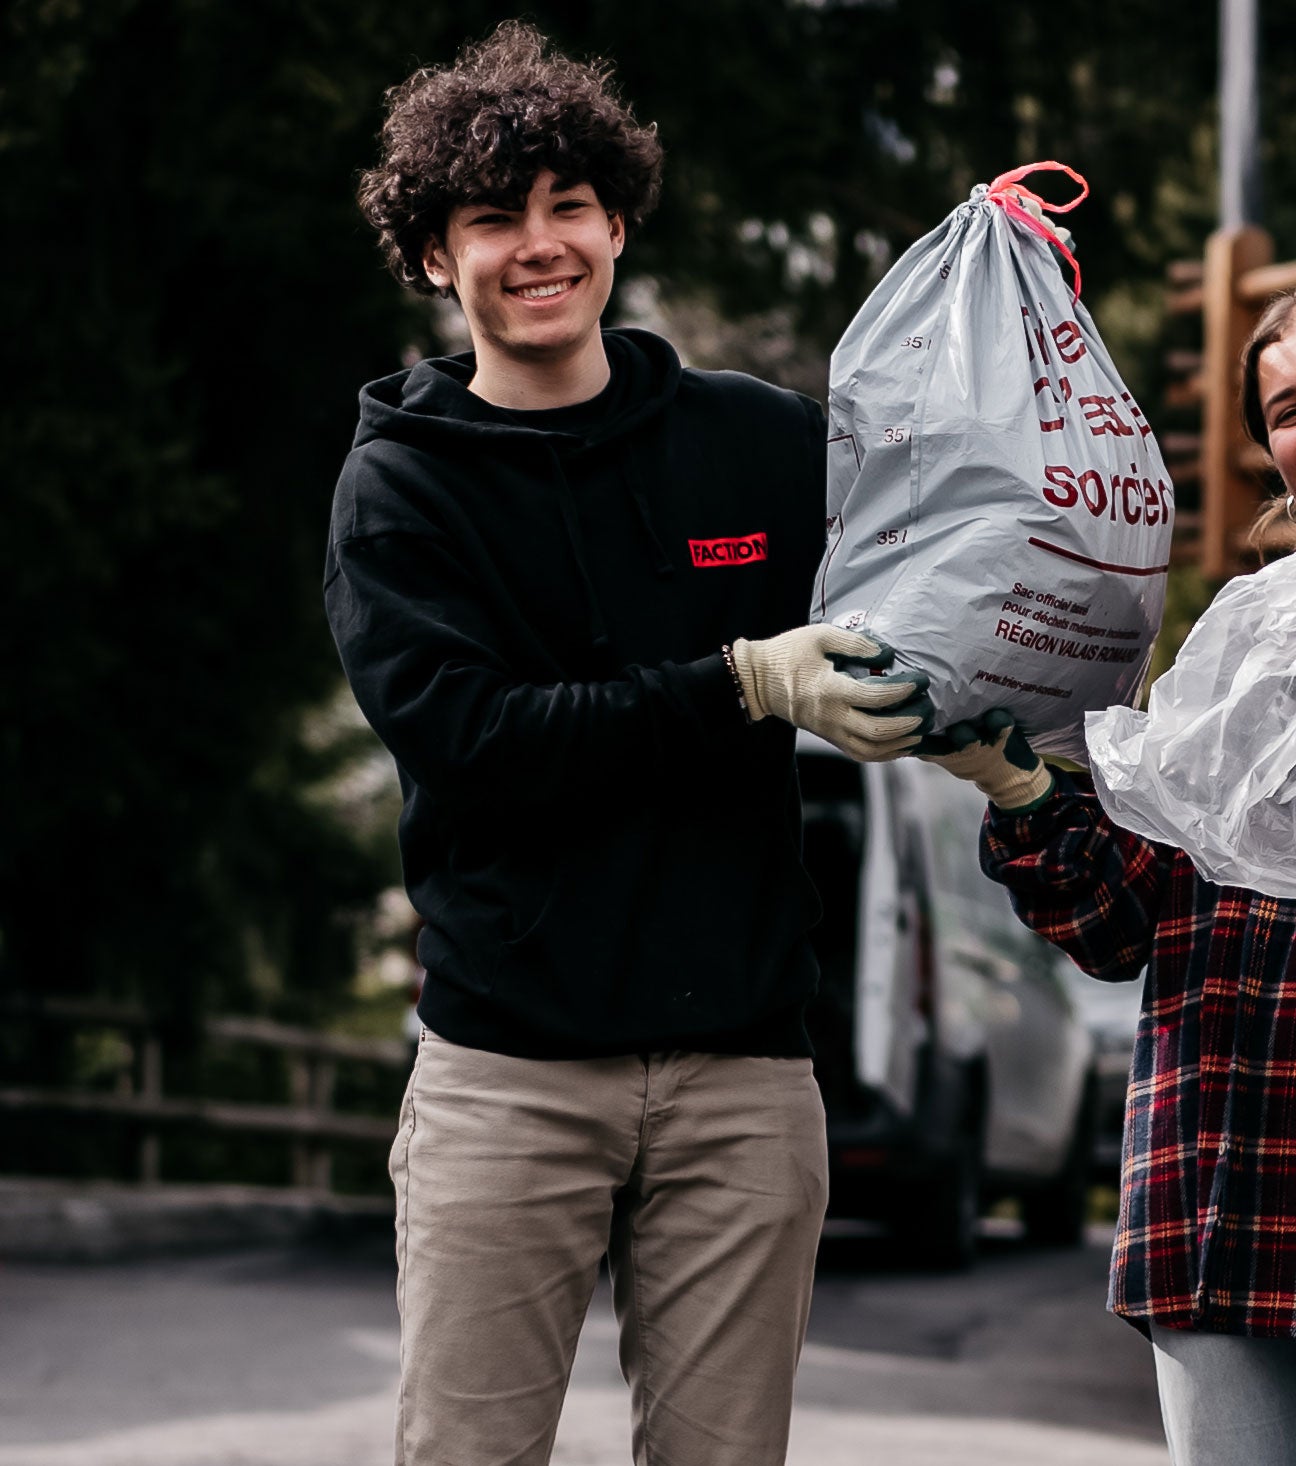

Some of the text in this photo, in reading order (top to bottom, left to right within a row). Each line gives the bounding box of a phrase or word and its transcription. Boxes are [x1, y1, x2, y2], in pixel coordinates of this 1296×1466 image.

[1042, 462, 1169, 526] sorcier
[693, 539, 767, 562] FACTION
[876, 530, 899, 545] 35
[1012, 582, 1035, 599] Sac
[1036, 593, 1071, 613] officiel
[1001, 600, 1032, 618] pour
[1032, 609, 1070, 630] déchets
[995, 619, 1058, 654] RÉGION
[1057, 637, 1100, 661] VALAIS
